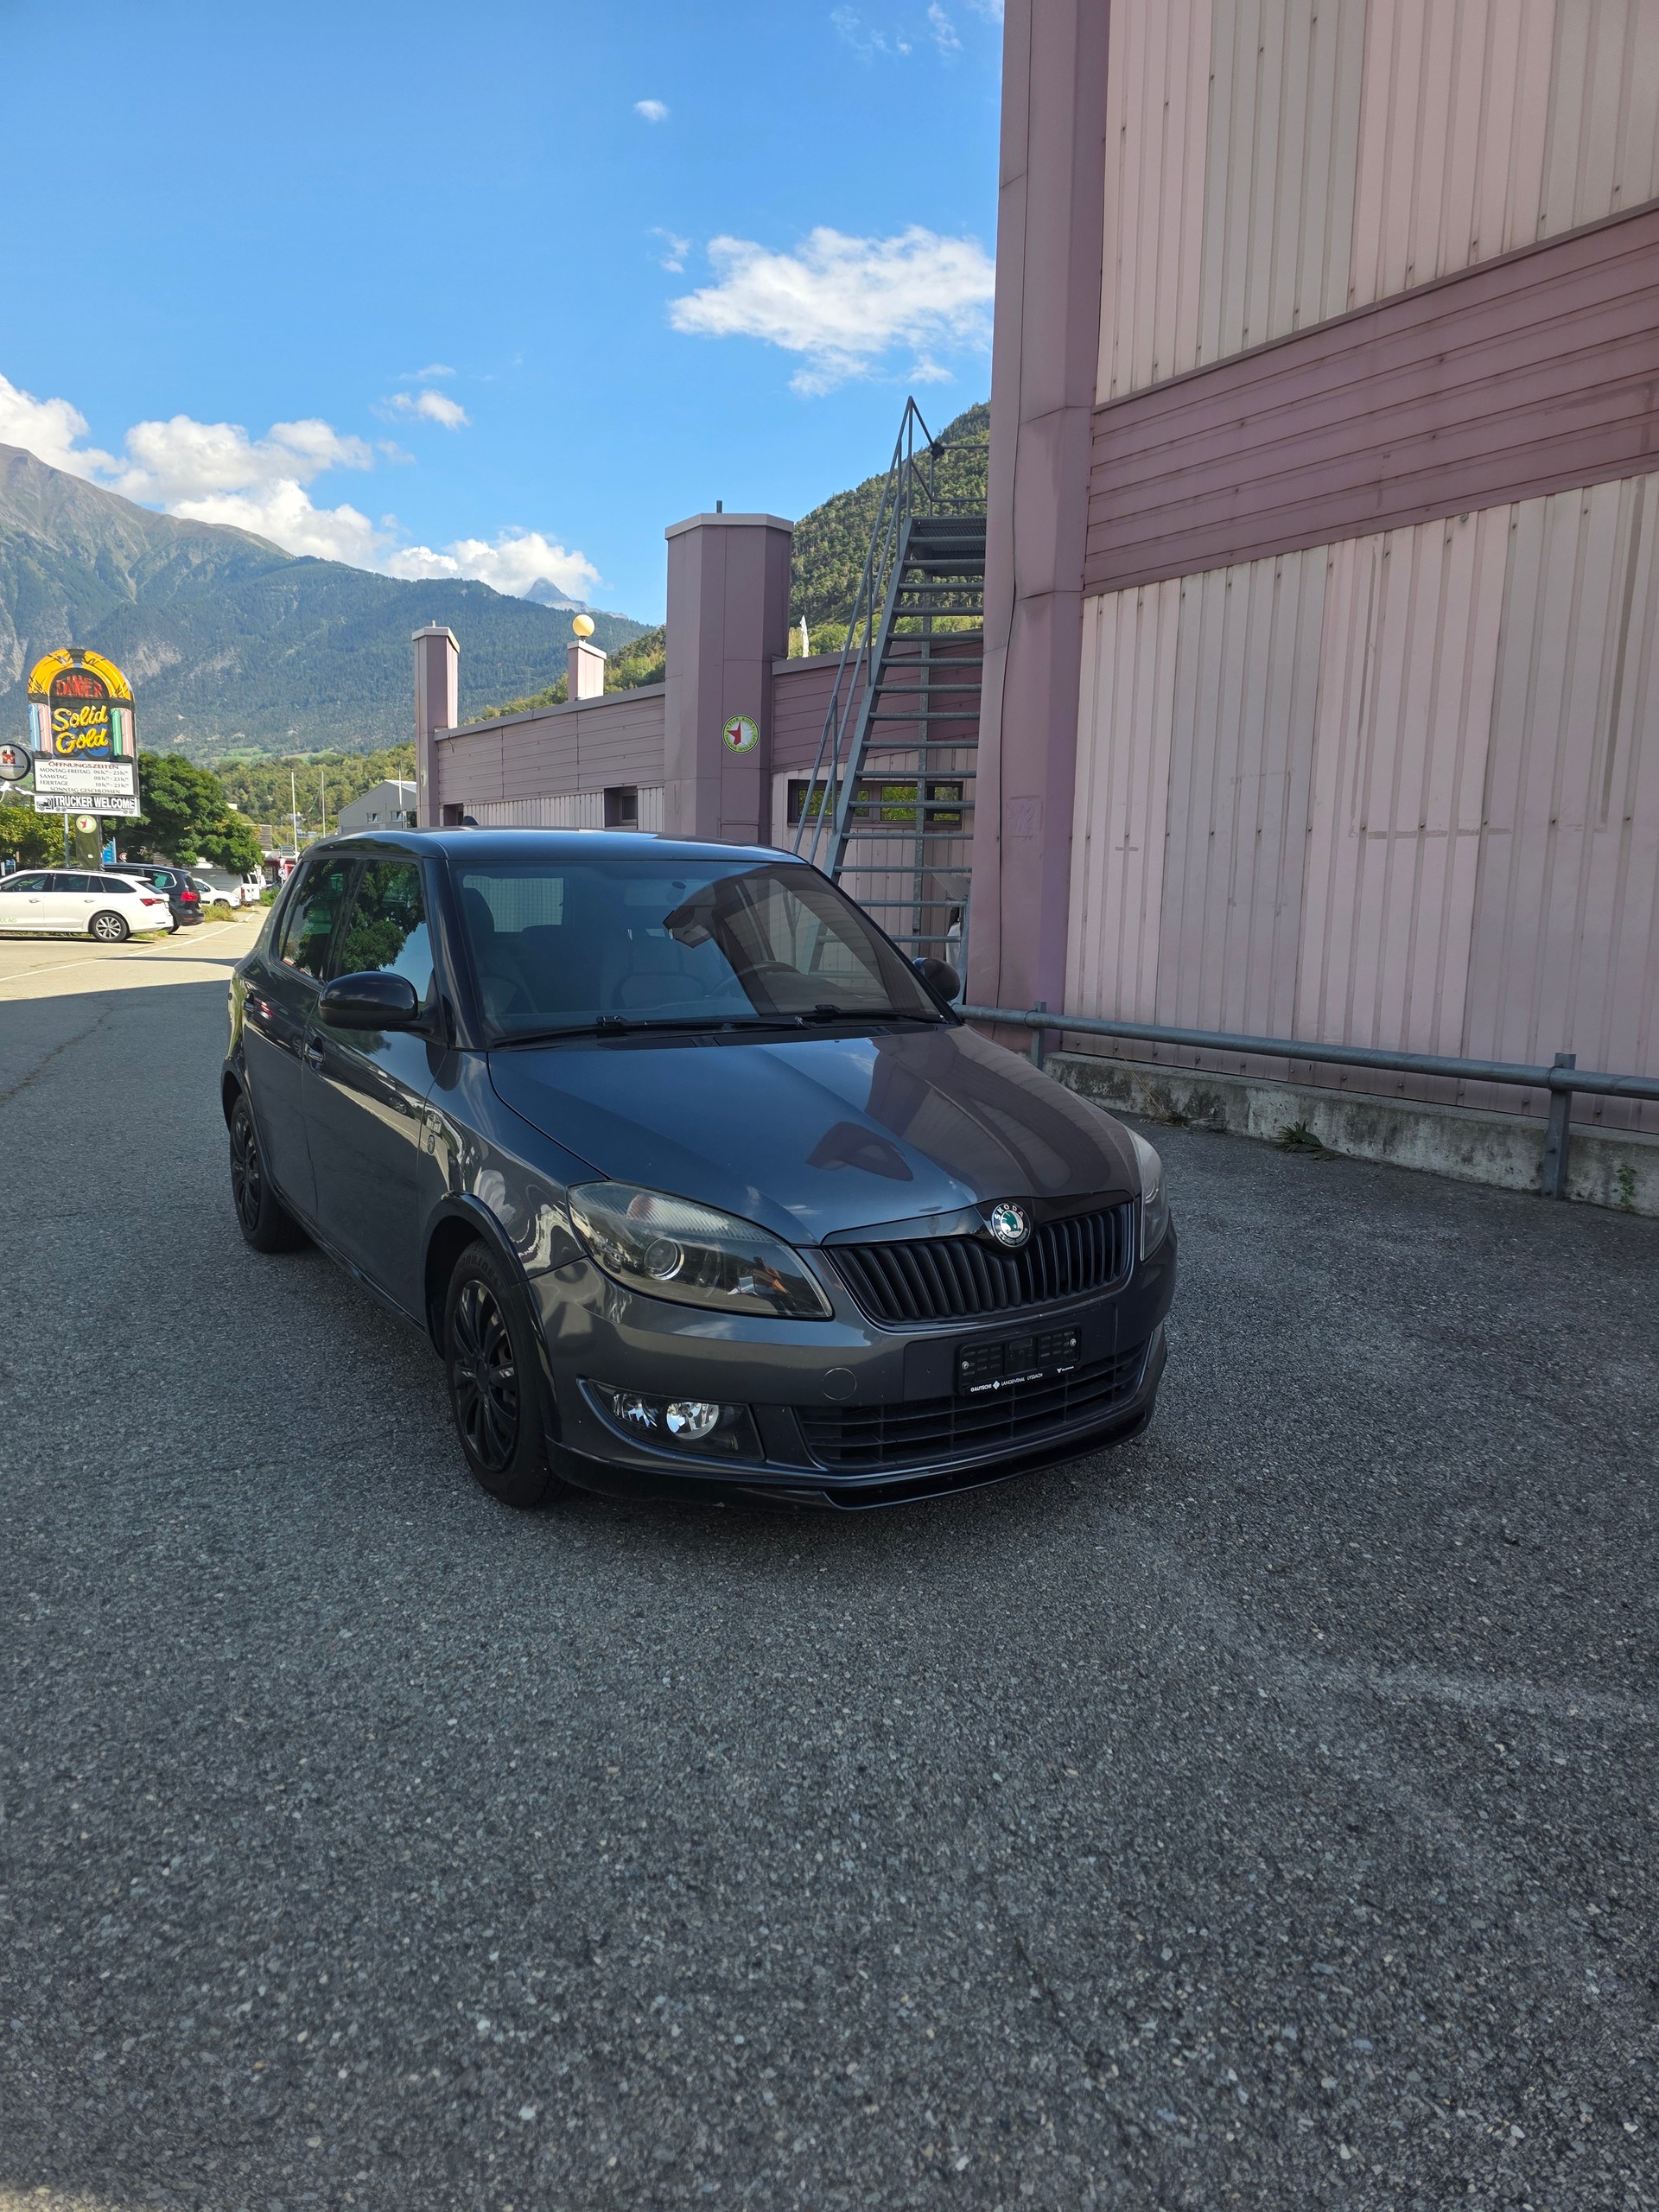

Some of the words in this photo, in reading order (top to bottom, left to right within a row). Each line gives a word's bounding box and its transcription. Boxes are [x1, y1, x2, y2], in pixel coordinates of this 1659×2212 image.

[55, 674, 104, 697] DINER
[52, 705, 108, 732] Solid
[55, 728, 109, 754] Gold
[54, 795, 93, 808] TRUCKER
[93, 797, 136, 810] WELCOME
